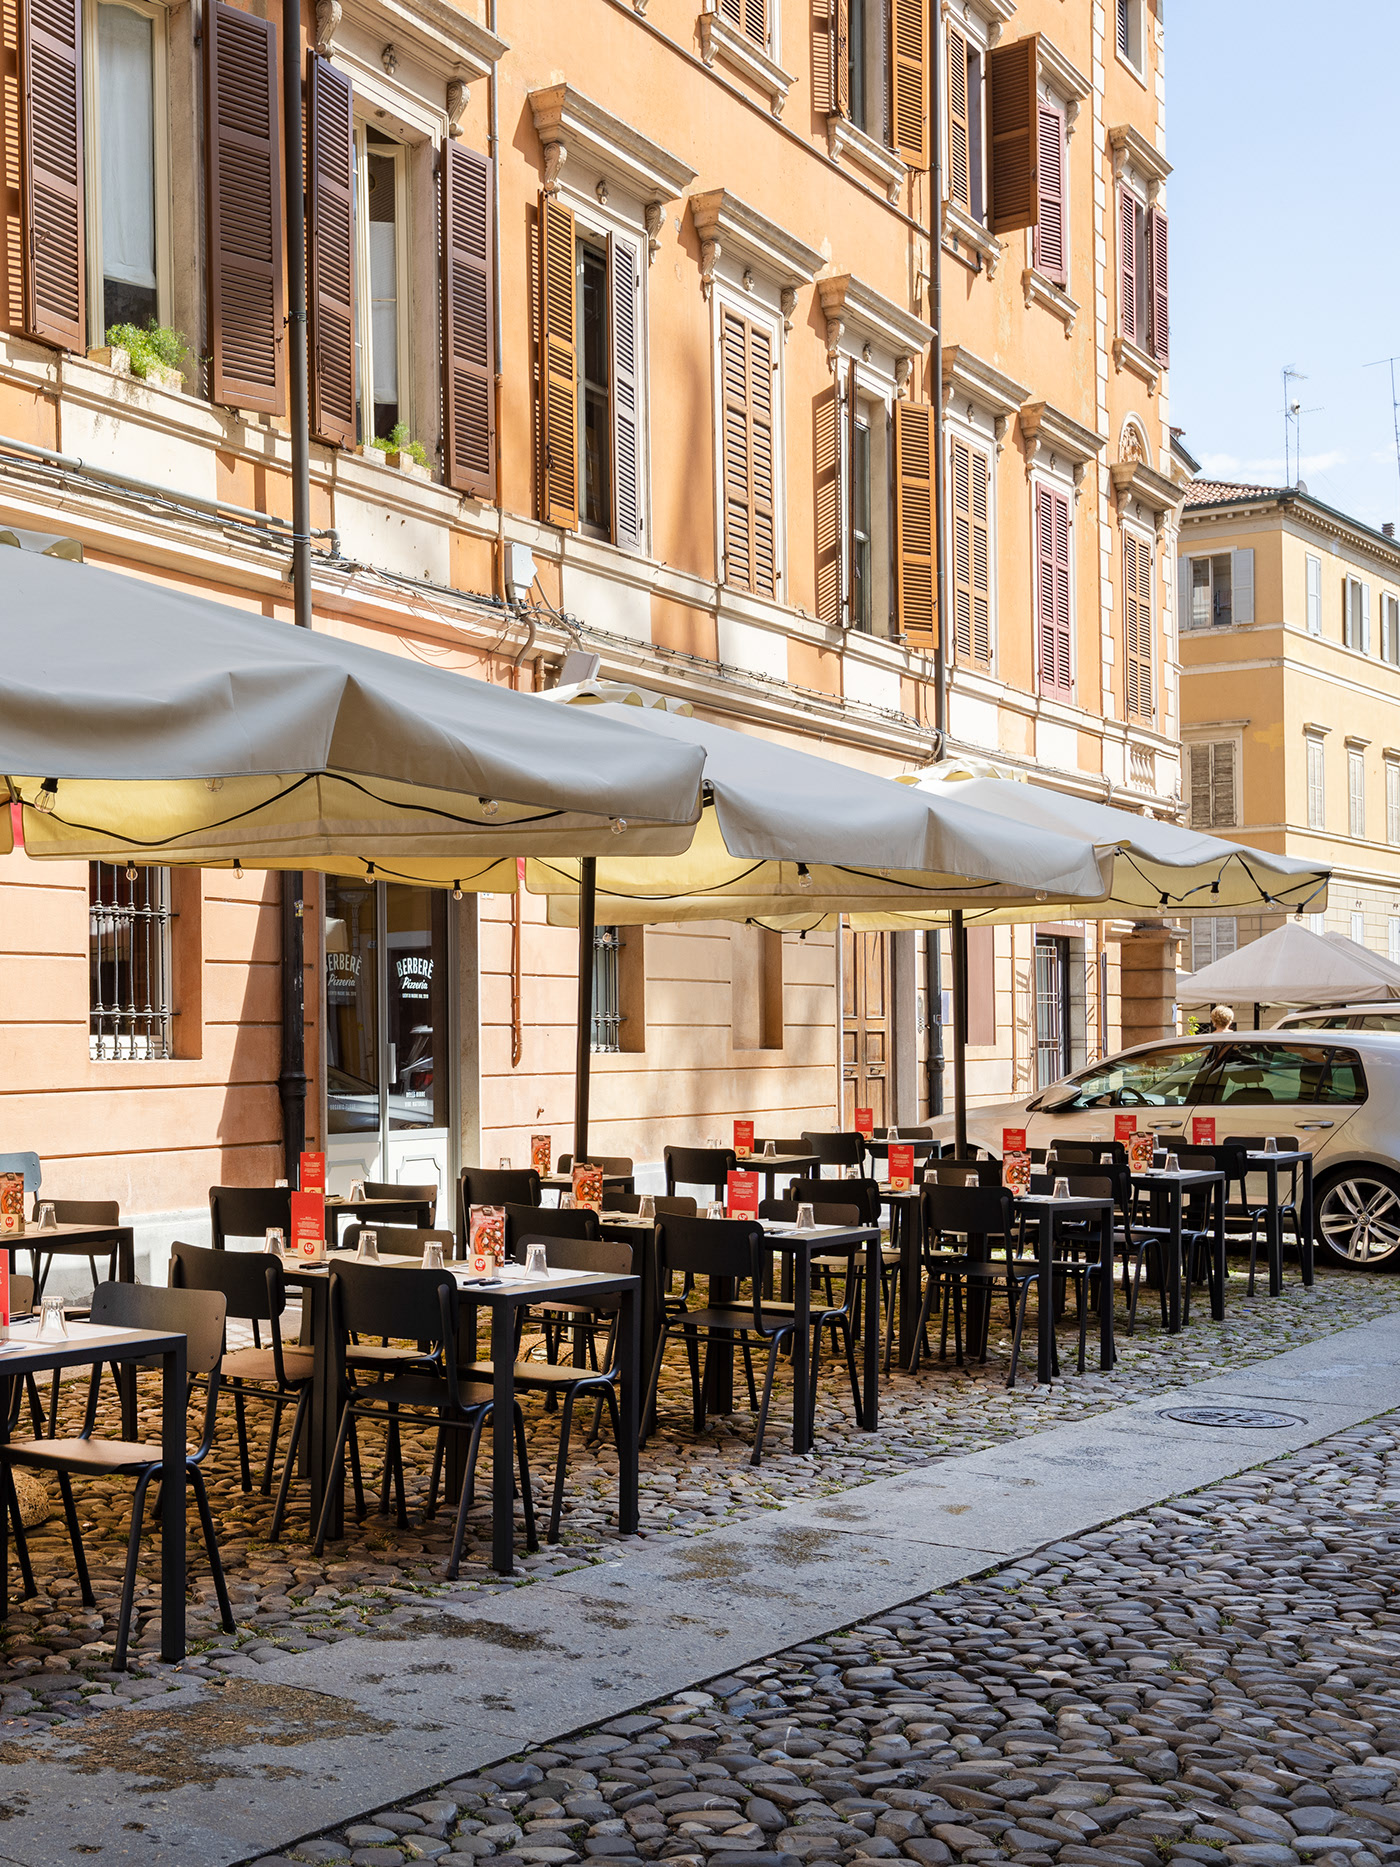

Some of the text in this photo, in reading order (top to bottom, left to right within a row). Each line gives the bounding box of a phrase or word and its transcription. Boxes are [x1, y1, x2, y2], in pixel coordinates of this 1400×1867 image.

[326, 953, 362, 975] ERBERÈ
[396, 957, 434, 979] BERBERÈ
[402, 976, 428, 990] Pizzeria
